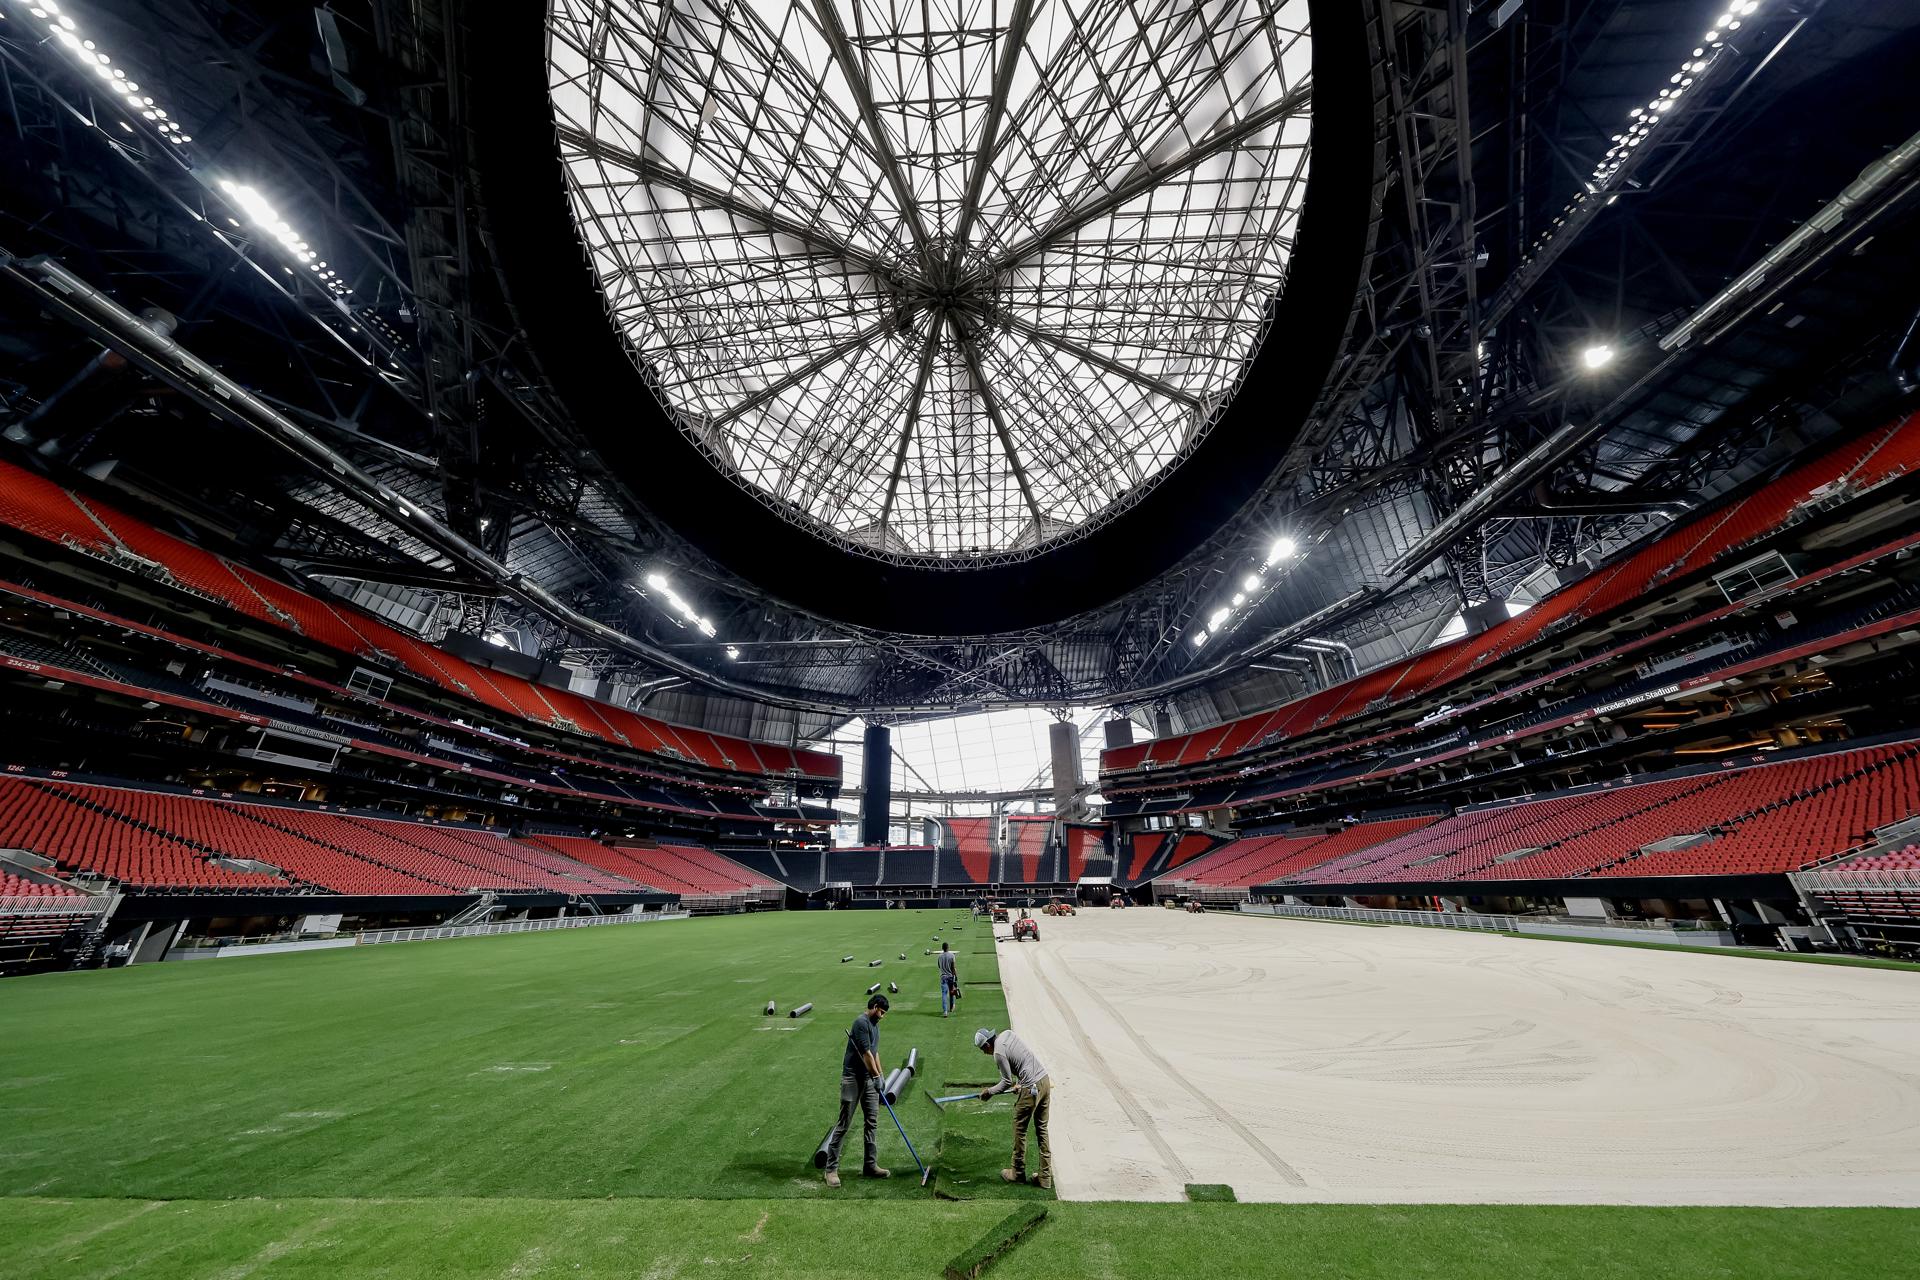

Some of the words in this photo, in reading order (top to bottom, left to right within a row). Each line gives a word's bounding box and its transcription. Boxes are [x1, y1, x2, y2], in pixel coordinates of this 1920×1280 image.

[7, 659, 41, 671] 234-235
[1593, 694, 1646, 715] Mercedes-Benz
[1645, 683, 1680, 700] Stadium
[324, 732, 353, 745] Stadium
[7, 764, 26, 772] 126C
[51, 770, 68, 778] 127C
